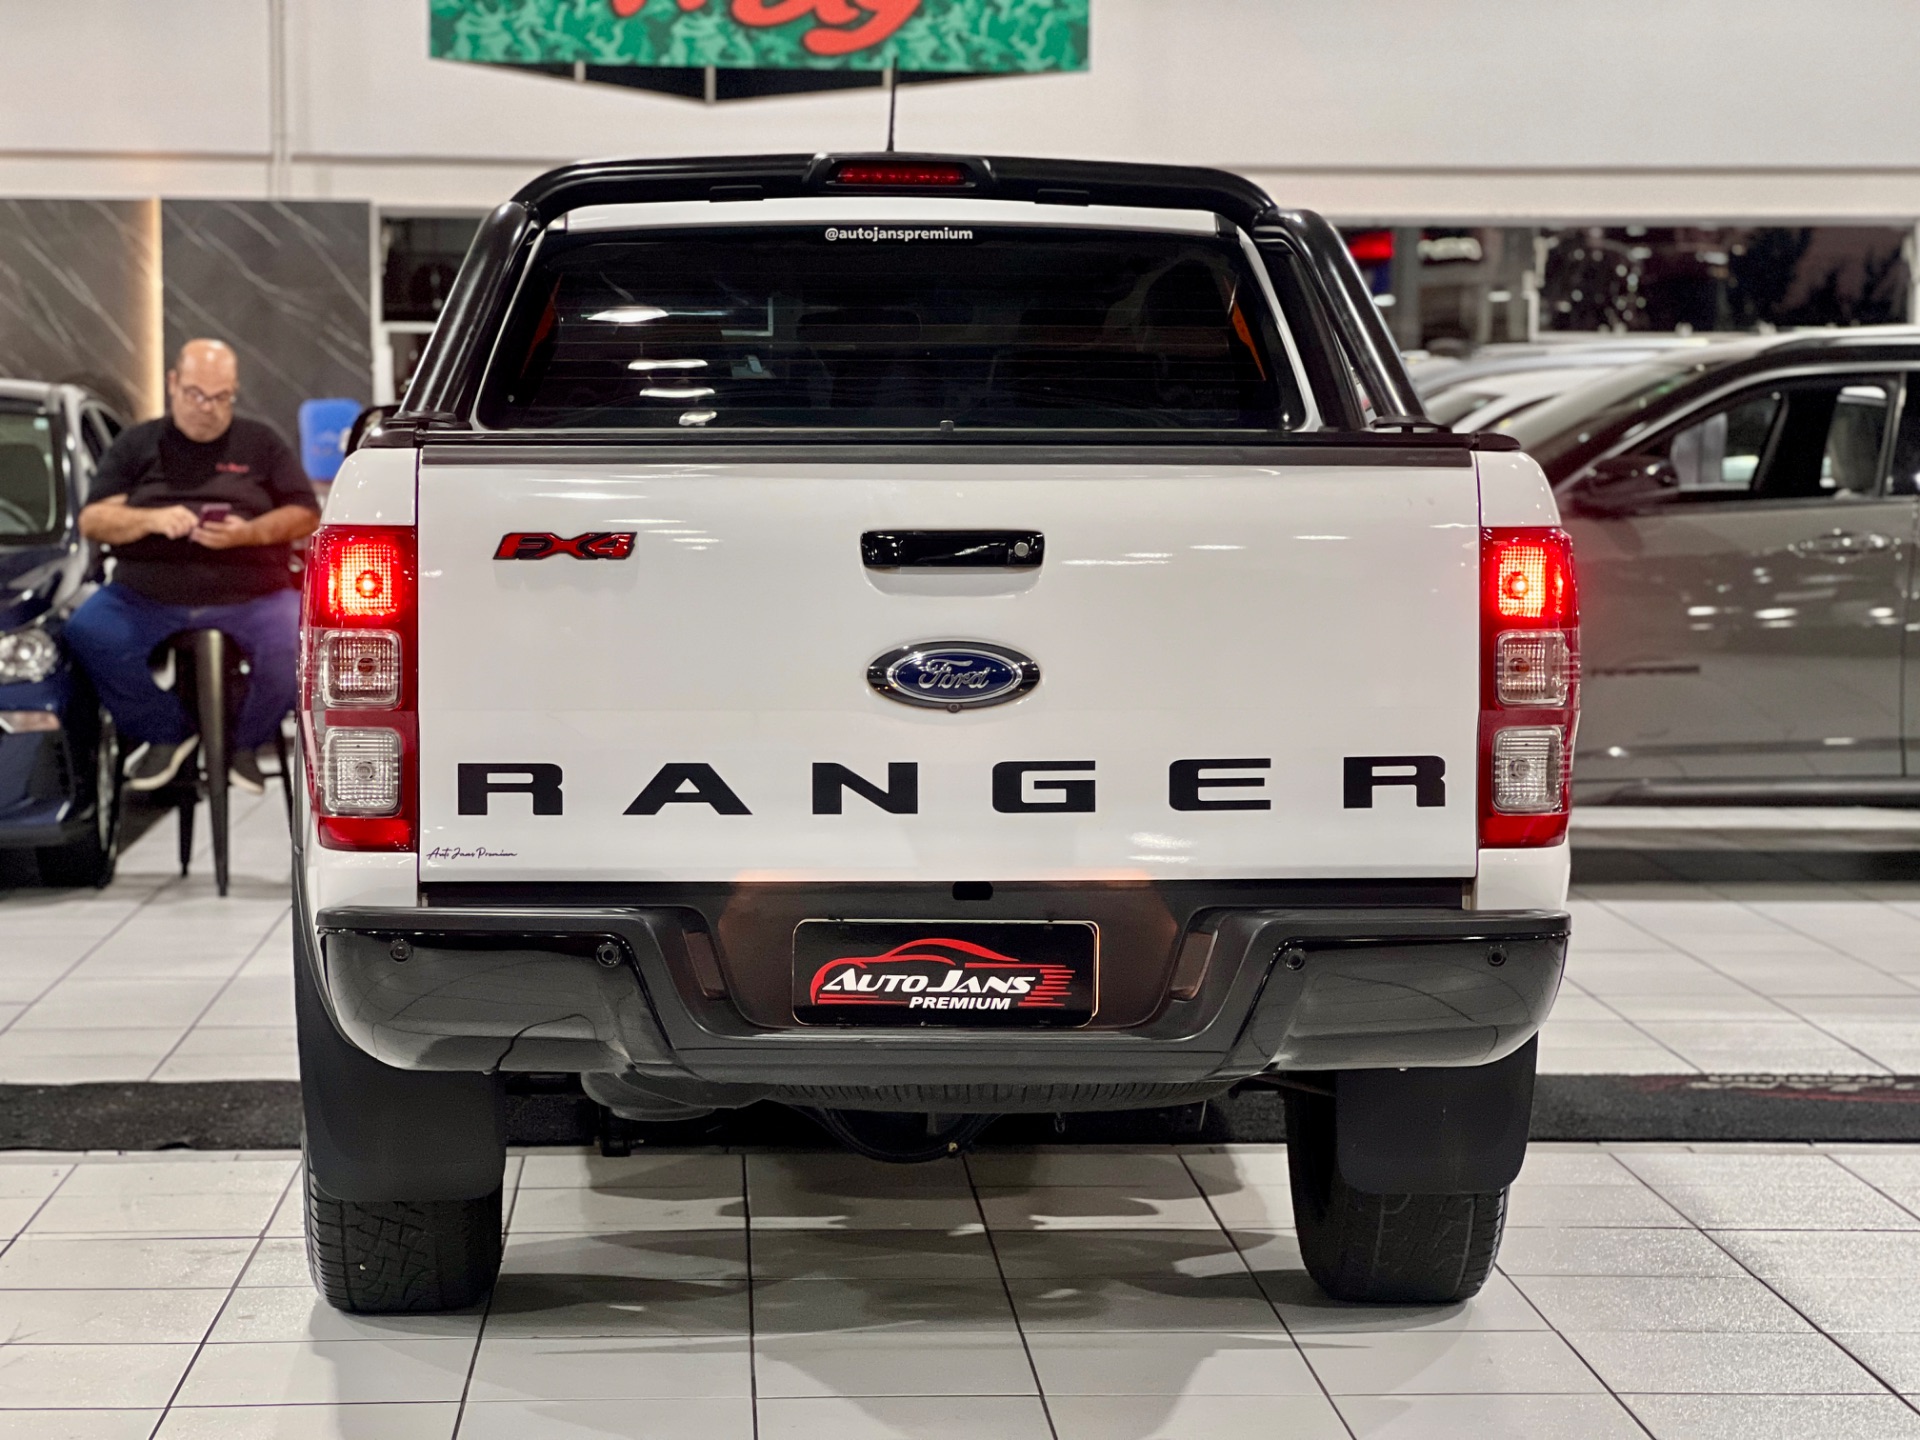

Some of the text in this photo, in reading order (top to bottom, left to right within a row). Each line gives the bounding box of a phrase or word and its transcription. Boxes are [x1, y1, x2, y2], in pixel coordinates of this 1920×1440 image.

[825, 227, 973, 242] @autojanspremium
[493, 532, 637, 560] FX4
[918, 659, 991, 689] Ford
[458, 756, 1446, 815] RANGER
[476, 847, 518, 859] Premium
[822, 968, 1036, 994] AUTO JANS
[909, 996, 1011, 1010] PREMIUM
